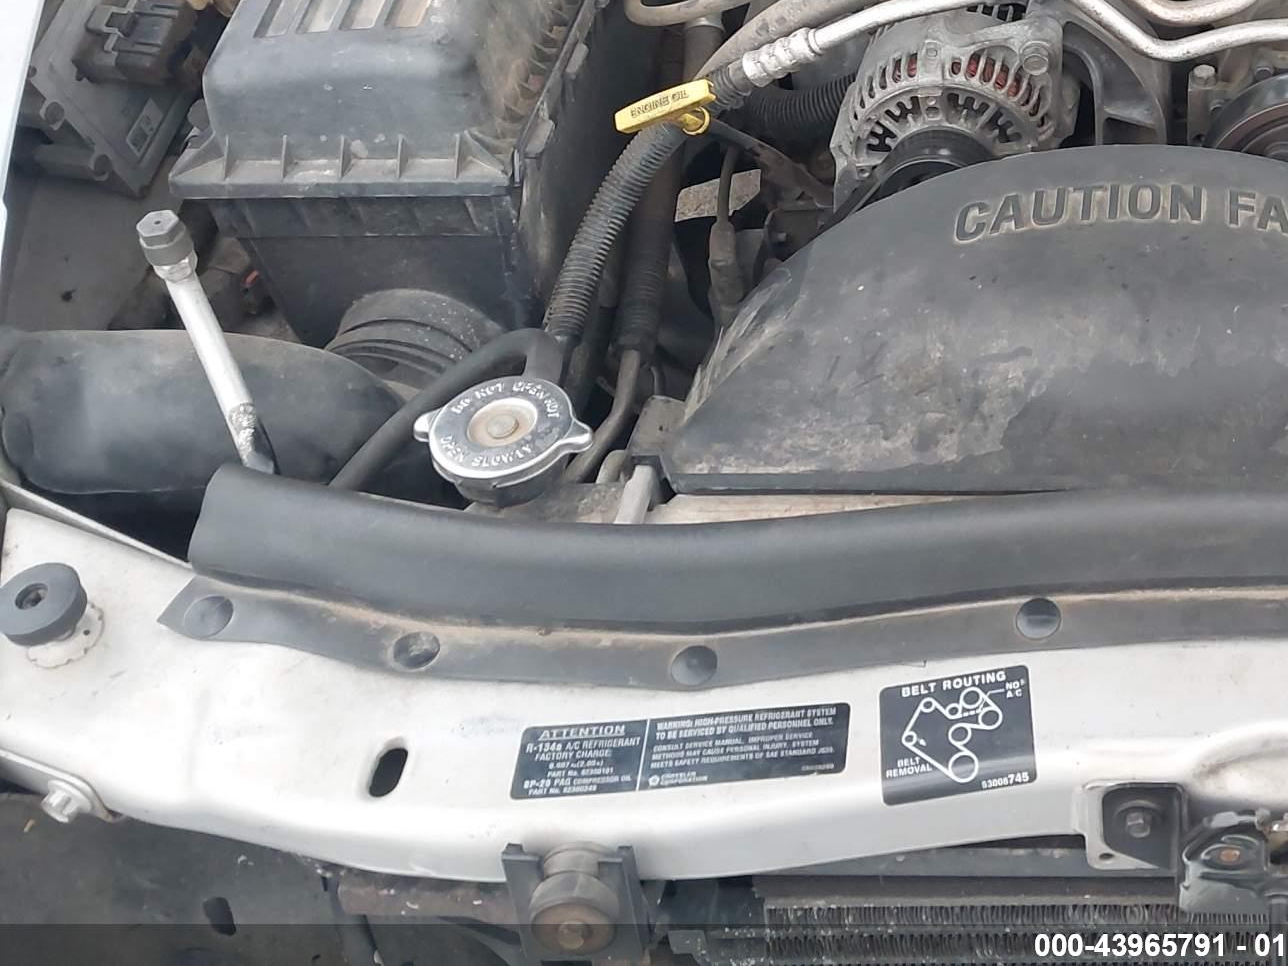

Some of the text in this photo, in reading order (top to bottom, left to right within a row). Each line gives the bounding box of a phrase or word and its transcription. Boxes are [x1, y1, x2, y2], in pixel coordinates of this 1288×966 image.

[631, 90, 689, 118] ENGINE OIL
[954, 182, 1208, 244] CAUTION
[475, 382, 505, 399] NOT
[901, 670, 1007, 698] BELT ROUTING
[694, 713, 753, 727] HIGH-PRESSURE
[755, 709, 806, 721] REFRIGERANT
[807, 706, 836, 717] SYSTEM
[540, 725, 625, 739] ATTENTION
[656, 732, 666, 740] TO
[667, 730, 677, 739] BE
[679, 727, 715, 738] SERVICED
[716, 725, 727, 735] BY
[728, 721, 767, 733] QUALIFIED
[768, 719, 812, 730] PERSONNEL
[526, 737, 640, 753] R-134a A/C REFRIGERANT
[535, 751, 574, 761] FACTORY
[897, 757, 921, 768] BELT
[886, 764, 932, 778] REMOVAL
